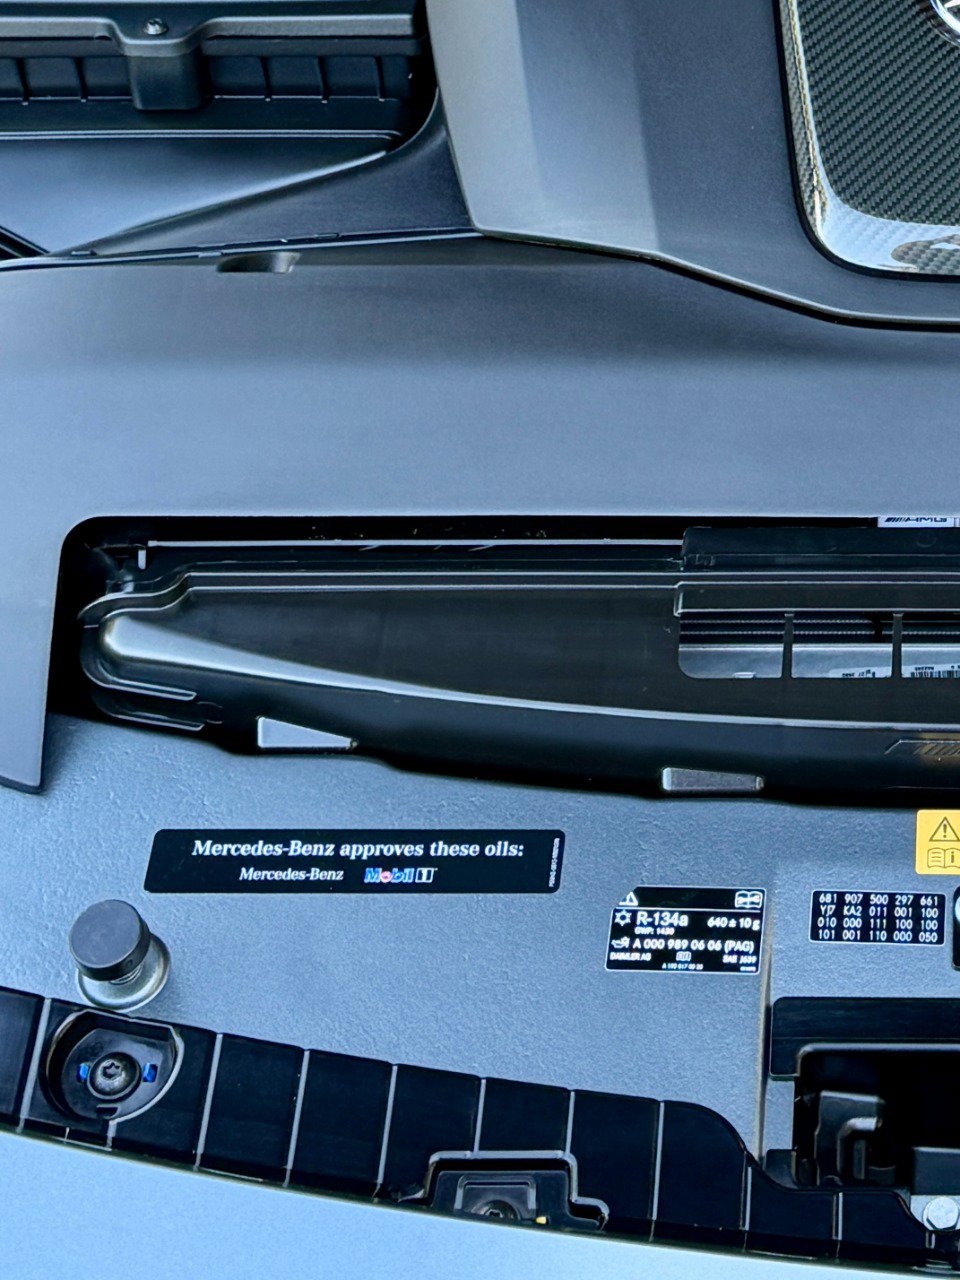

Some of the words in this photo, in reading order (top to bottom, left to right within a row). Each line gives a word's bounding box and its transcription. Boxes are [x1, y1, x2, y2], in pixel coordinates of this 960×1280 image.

[192, 840, 335, 858] Mercedes-Benz
[340, 842, 424, 861] approves
[430, 840, 480, 858] these
[485, 840, 524, 858] oils:
[239, 867, 344, 882] Mercedes-Benz
[364, 868, 415, 883] Mobil
[819, 894, 837, 903] 681
[845, 894, 863, 904] 907
[870, 894, 888, 904] 500
[895, 895, 914, 905] 297
[920, 896, 938, 905] 661
[844, 906, 862, 916] KA2
[869, 907, 887, 916] 011
[894, 908, 912, 917] 001
[921, 908, 938, 918] 100
[636, 912, 689, 927] R-134a
[707, 916, 728, 928] 640
[739, 918, 752, 928] 10
[818, 917, 836, 927] 010
[843, 918, 862, 928] 000
[870, 919, 886, 928] 111
[895, 919, 913, 929] 100
[921, 921, 938, 930] 100
[818, 929, 835, 939] 101
[842, 930, 860, 940] 001
[870, 931, 887, 941] 110
[894, 931, 912, 941] 000
[919, 932, 937, 942] 050
[632, 938, 641, 949] A
[643, 938, 665, 949] 000
[667, 939, 688, 950] 989
[690, 939, 705, 950] 06
[707, 940, 722, 951] 06
[724, 940, 754, 954] (PAG)
